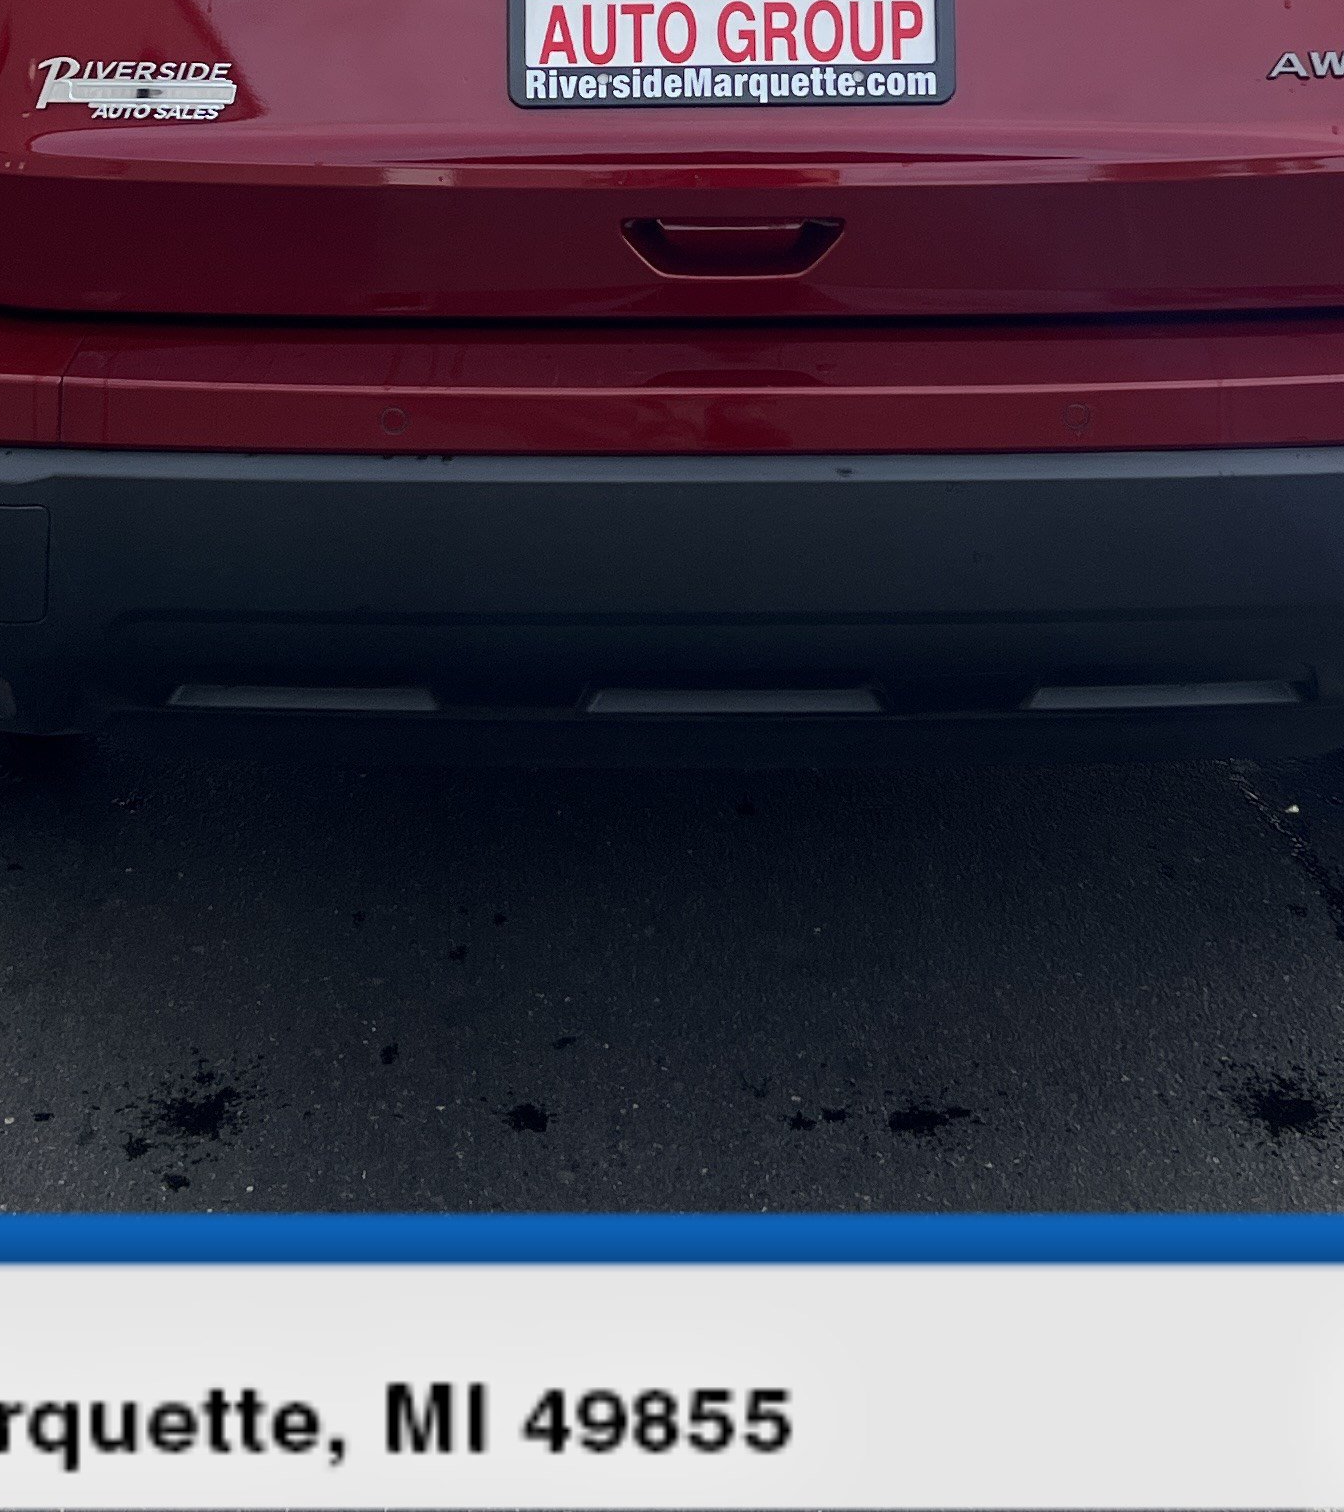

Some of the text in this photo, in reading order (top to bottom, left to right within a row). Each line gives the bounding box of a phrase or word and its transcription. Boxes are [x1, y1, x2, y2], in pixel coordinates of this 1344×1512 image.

[538, 1, 924, 65] AUTO GROUP
[36, 56, 231, 109] RIVERSIDE
[525, 68, 937, 103] RiversideMarquette.com
[92, 105, 219, 119] AUTO SALES
